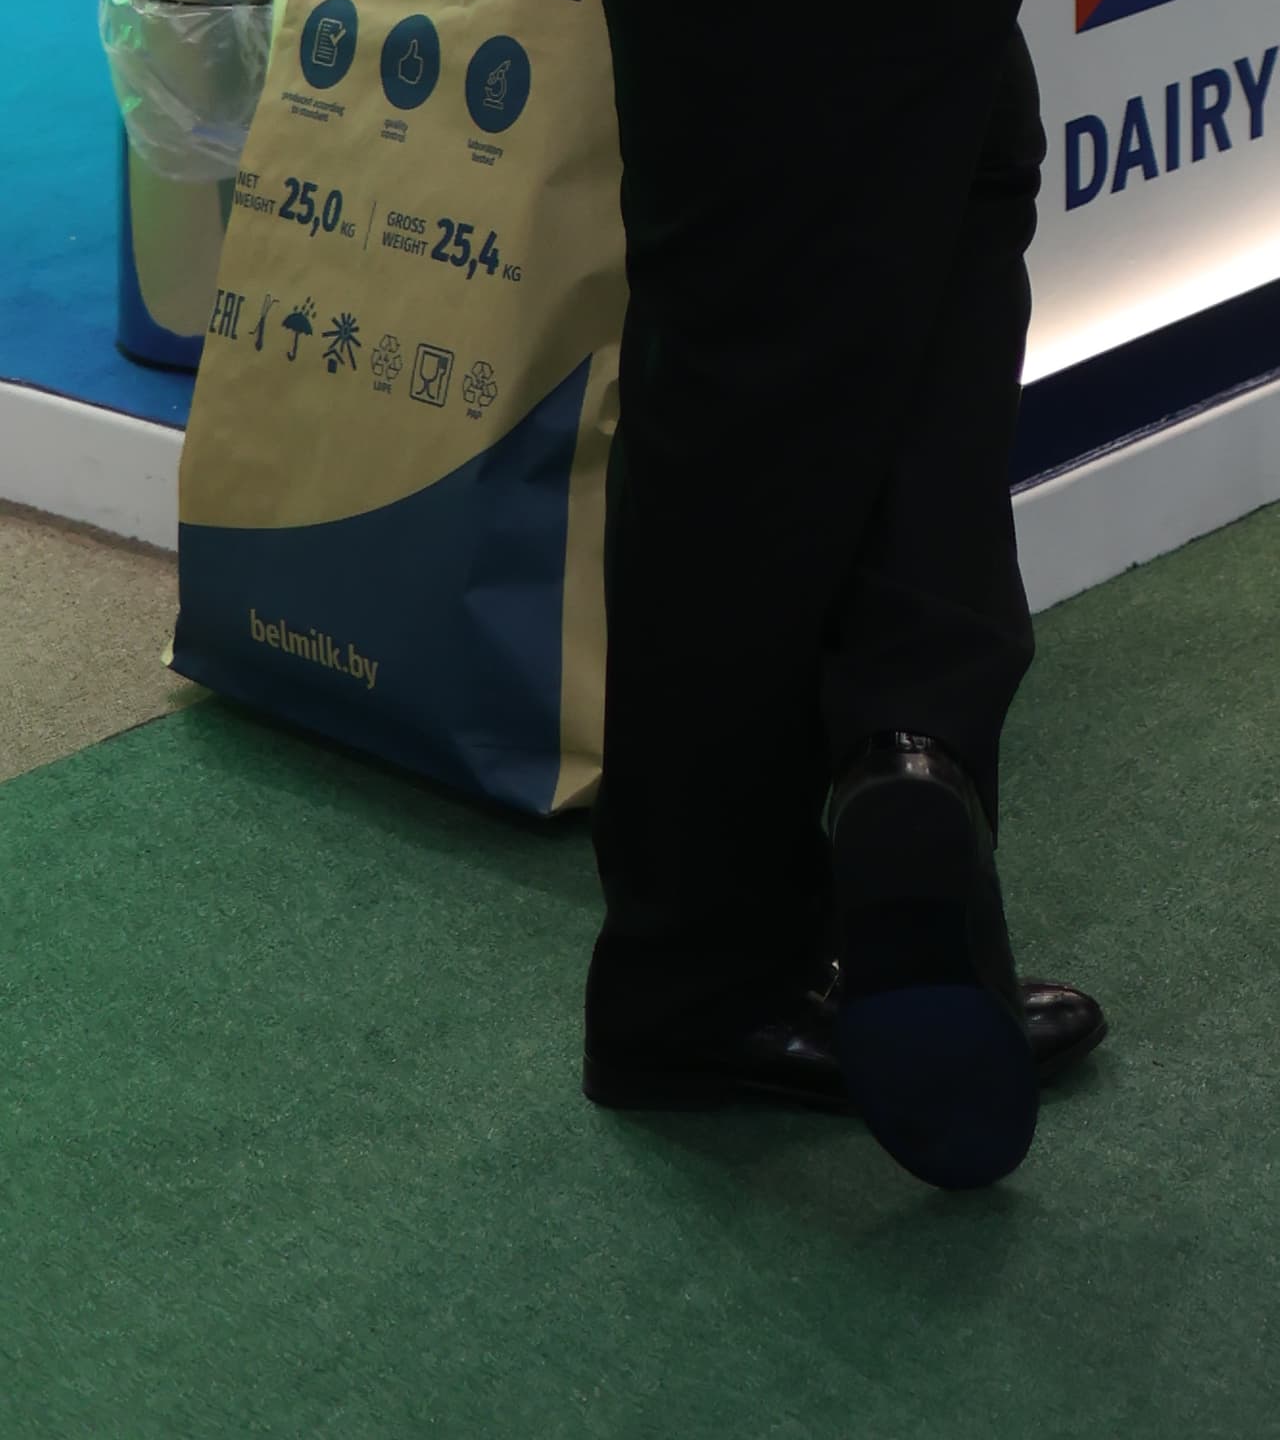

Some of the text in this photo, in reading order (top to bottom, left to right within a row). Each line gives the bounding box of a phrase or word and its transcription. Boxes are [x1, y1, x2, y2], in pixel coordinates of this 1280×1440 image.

[1065, 45, 1279, 212] DAIRY
[235, 177, 356, 238] WEIGHT 25,0 KG
[236, 171, 260, 189] NET
[382, 218, 522, 282] WEIGHT 25,4 KG
[387, 211, 427, 234] GROSS
[250, 607, 379, 690] belmilk.by
